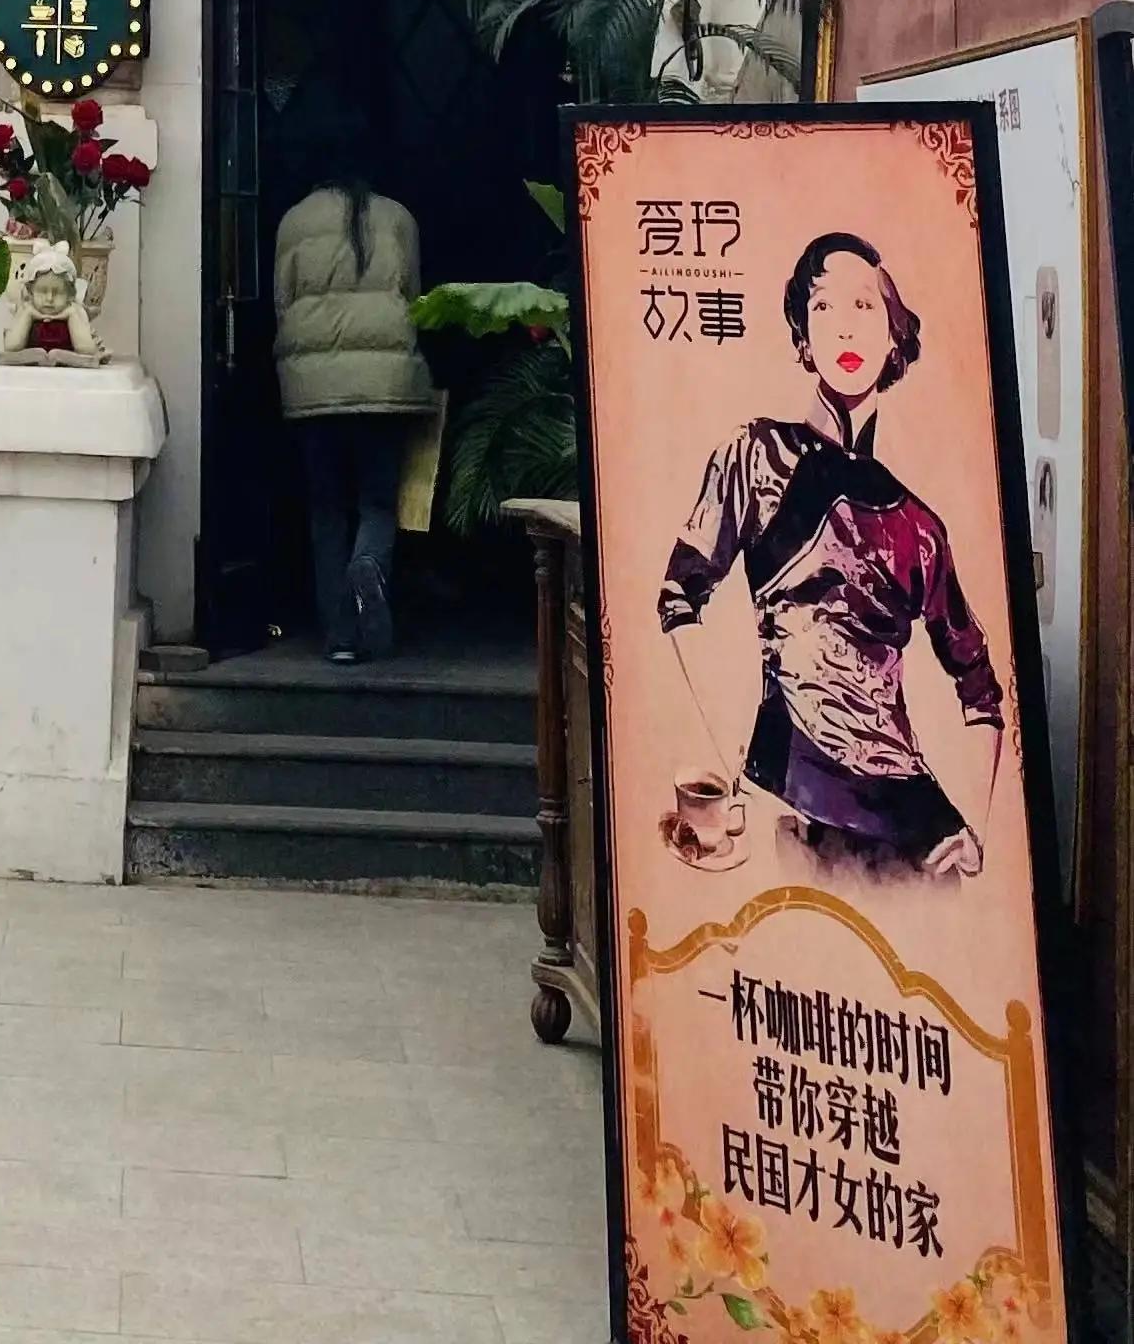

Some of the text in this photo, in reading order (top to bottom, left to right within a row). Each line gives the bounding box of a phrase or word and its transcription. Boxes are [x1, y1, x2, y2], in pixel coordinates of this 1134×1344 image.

[635, 200, 741, 258] 爱玲
[639, 284, 747, 346] 故事
[698, 969, 951, 1096] 一杯咖啡的时间
[752, 1056, 900, 1165] 带你穿越
[722, 1123, 944, 1258] 民国才女的家
